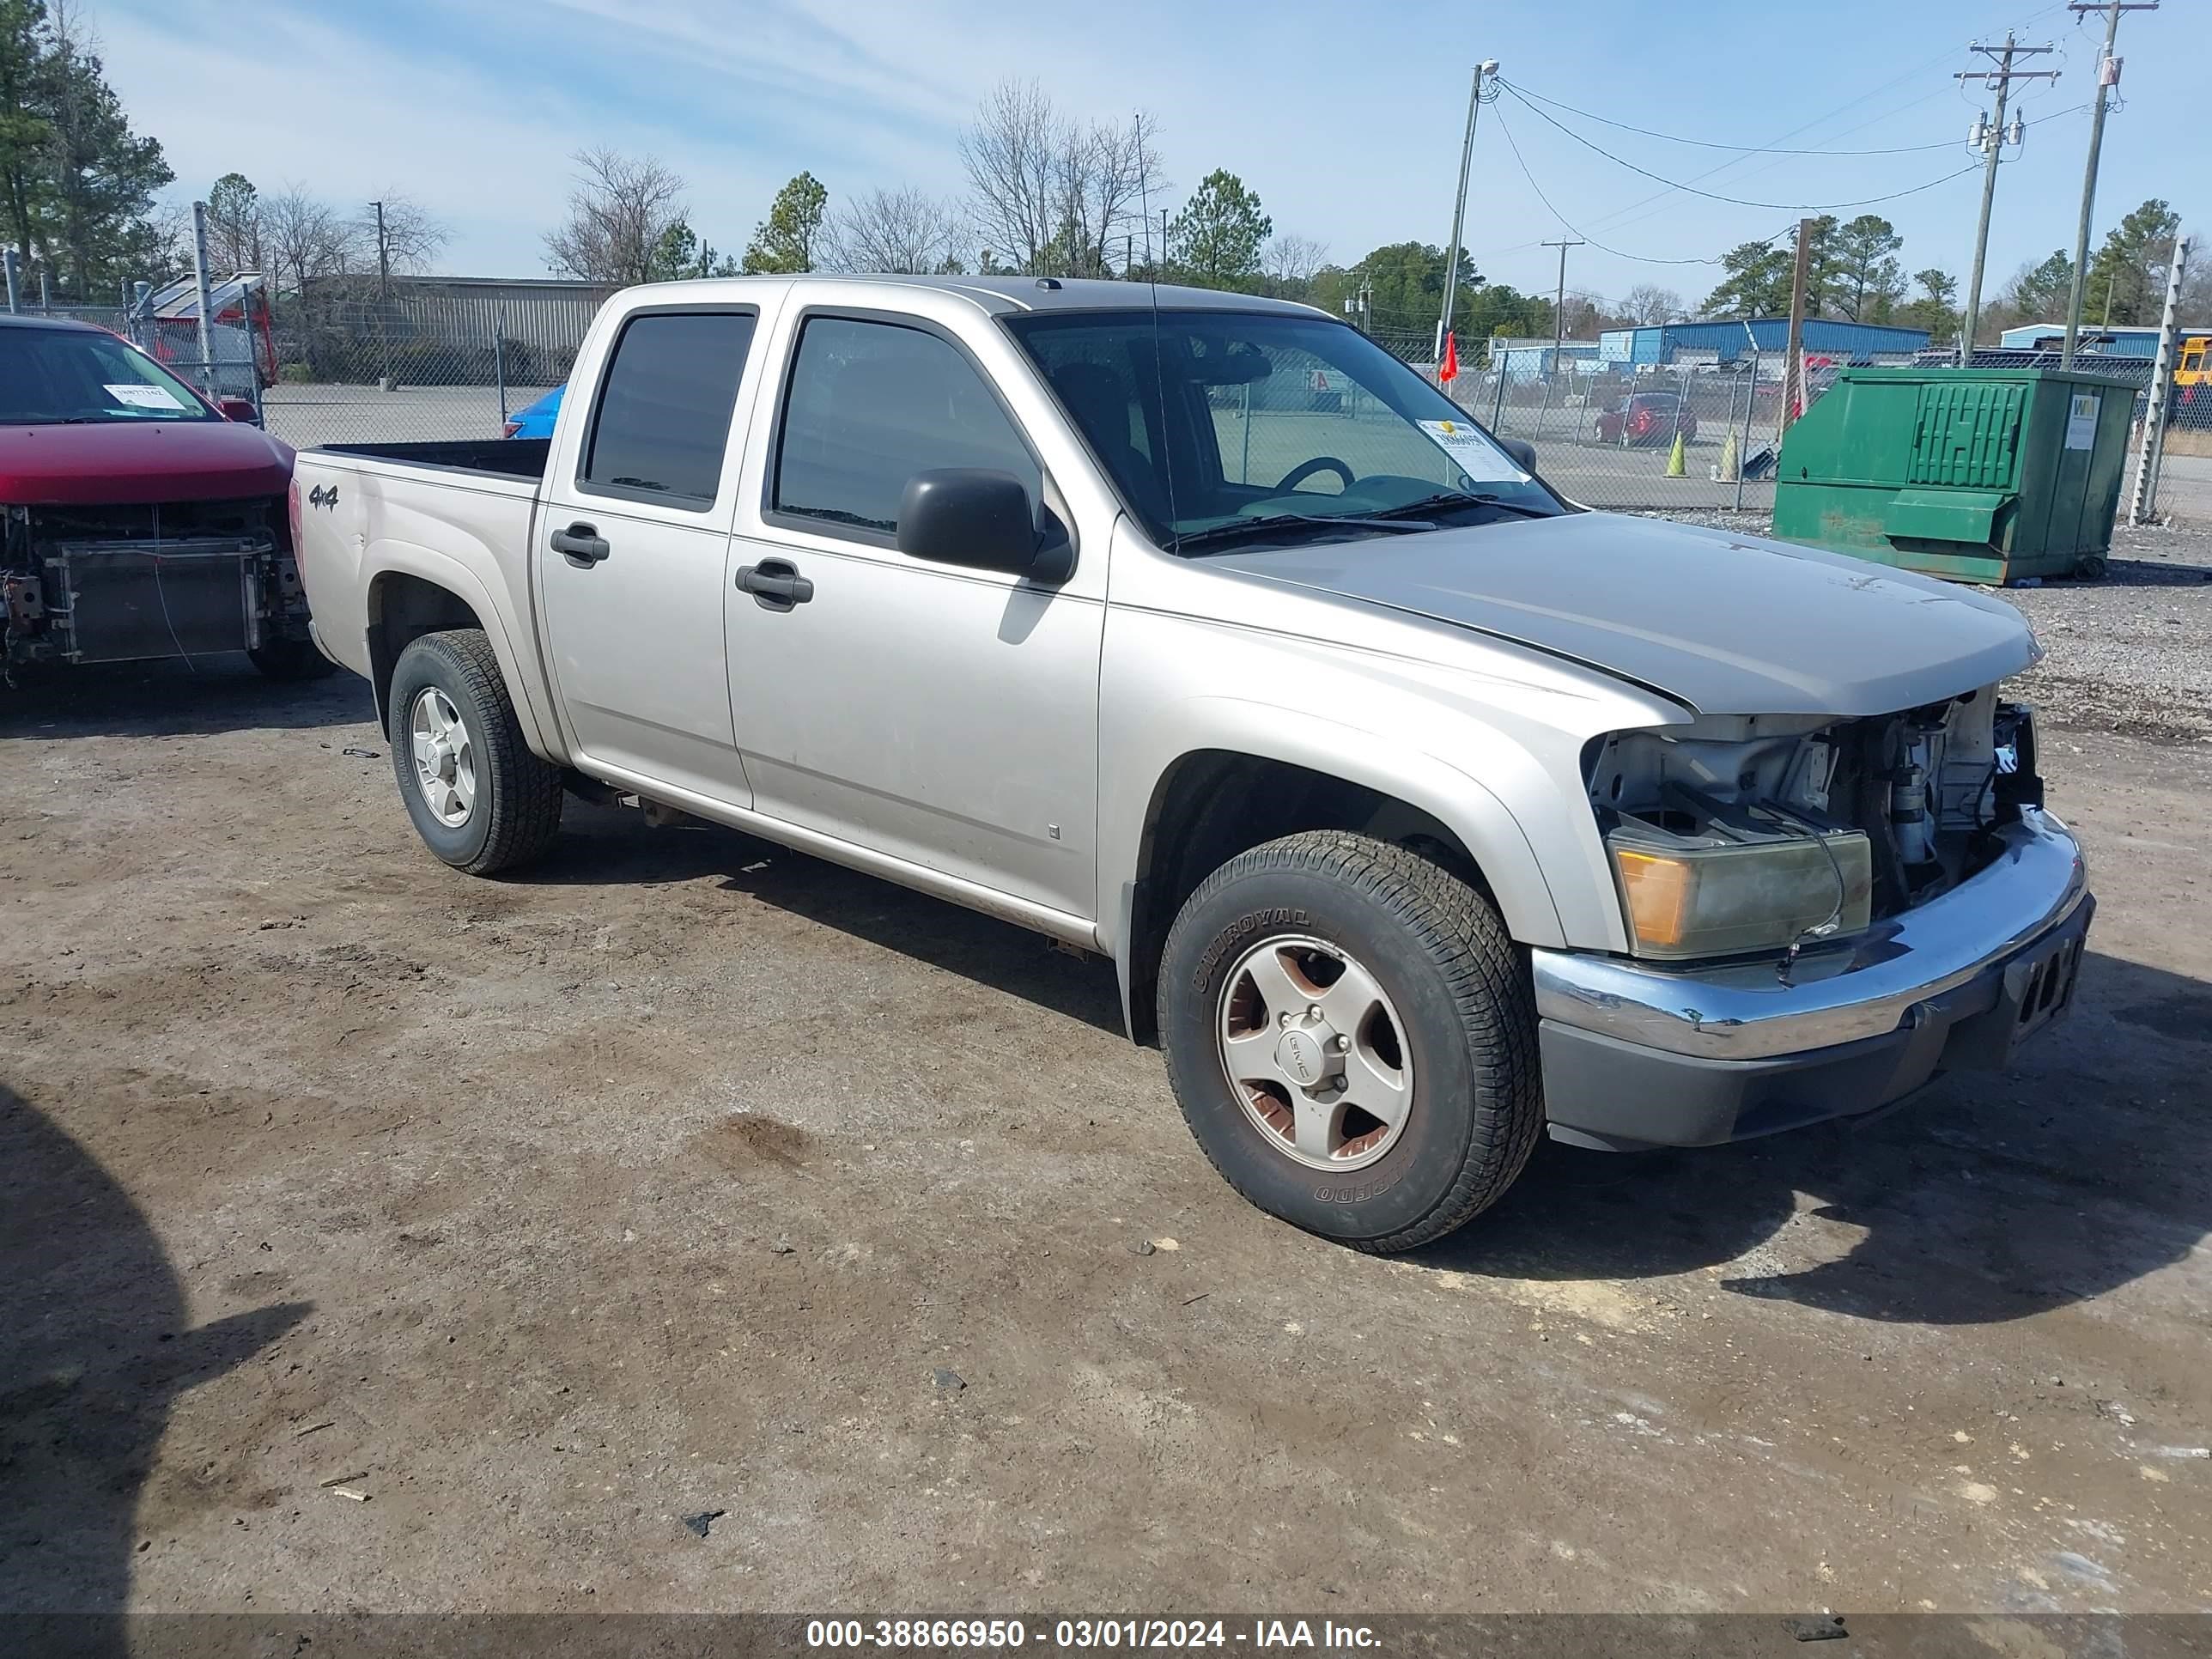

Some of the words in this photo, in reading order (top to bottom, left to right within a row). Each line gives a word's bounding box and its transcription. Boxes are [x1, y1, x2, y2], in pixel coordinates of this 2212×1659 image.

[1436, 433, 1486, 447] 38866950
[309, 483, 339, 514] 4x4
[1193, 908, 1311, 994] UNIROYAL
[1290, 1037, 1310, 1079] GMC
[1313, 1146, 1417, 1204] AREDO
